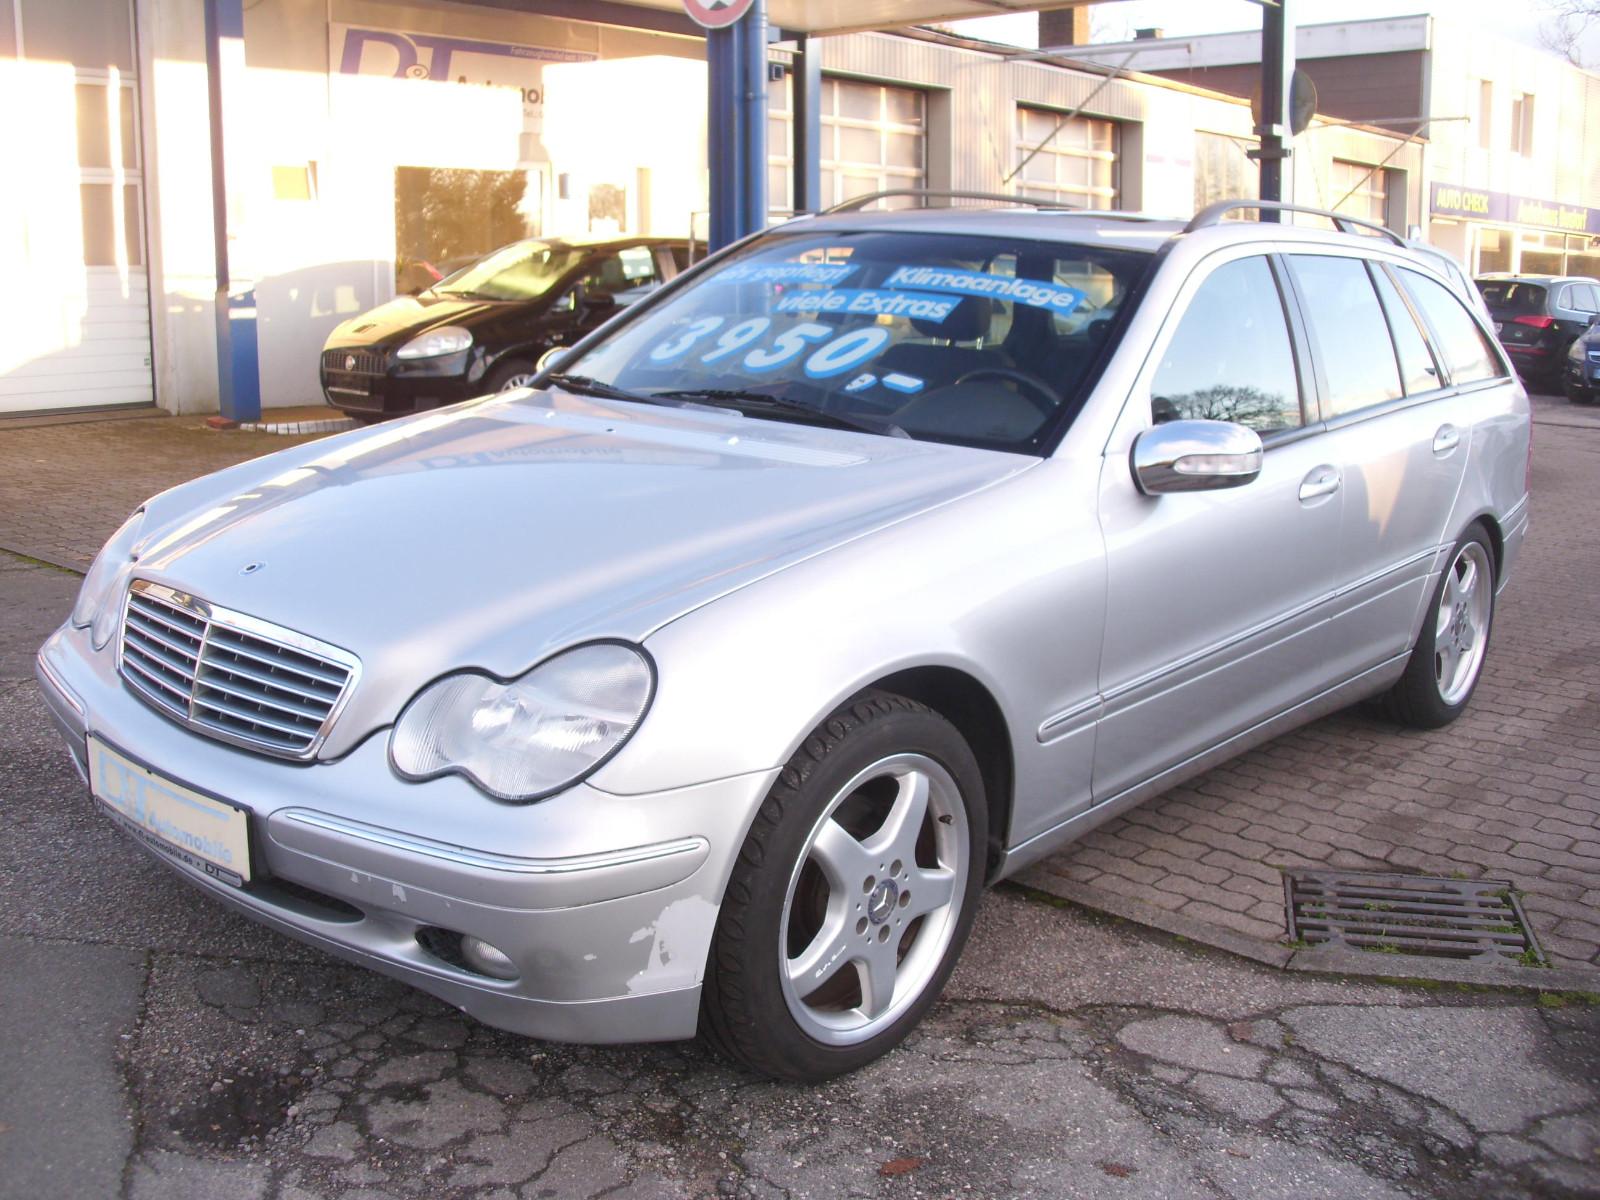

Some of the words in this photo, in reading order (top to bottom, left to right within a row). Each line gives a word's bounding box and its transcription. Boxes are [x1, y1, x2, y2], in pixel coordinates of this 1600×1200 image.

[1436, 187, 1461, 210] AUTO
[1463, 191, 1489, 214] CHECK
[890, 265, 1075, 308] Klimaanlage
[777, 291, 845, 311] viele
[848, 292, 952, 319] Extras
